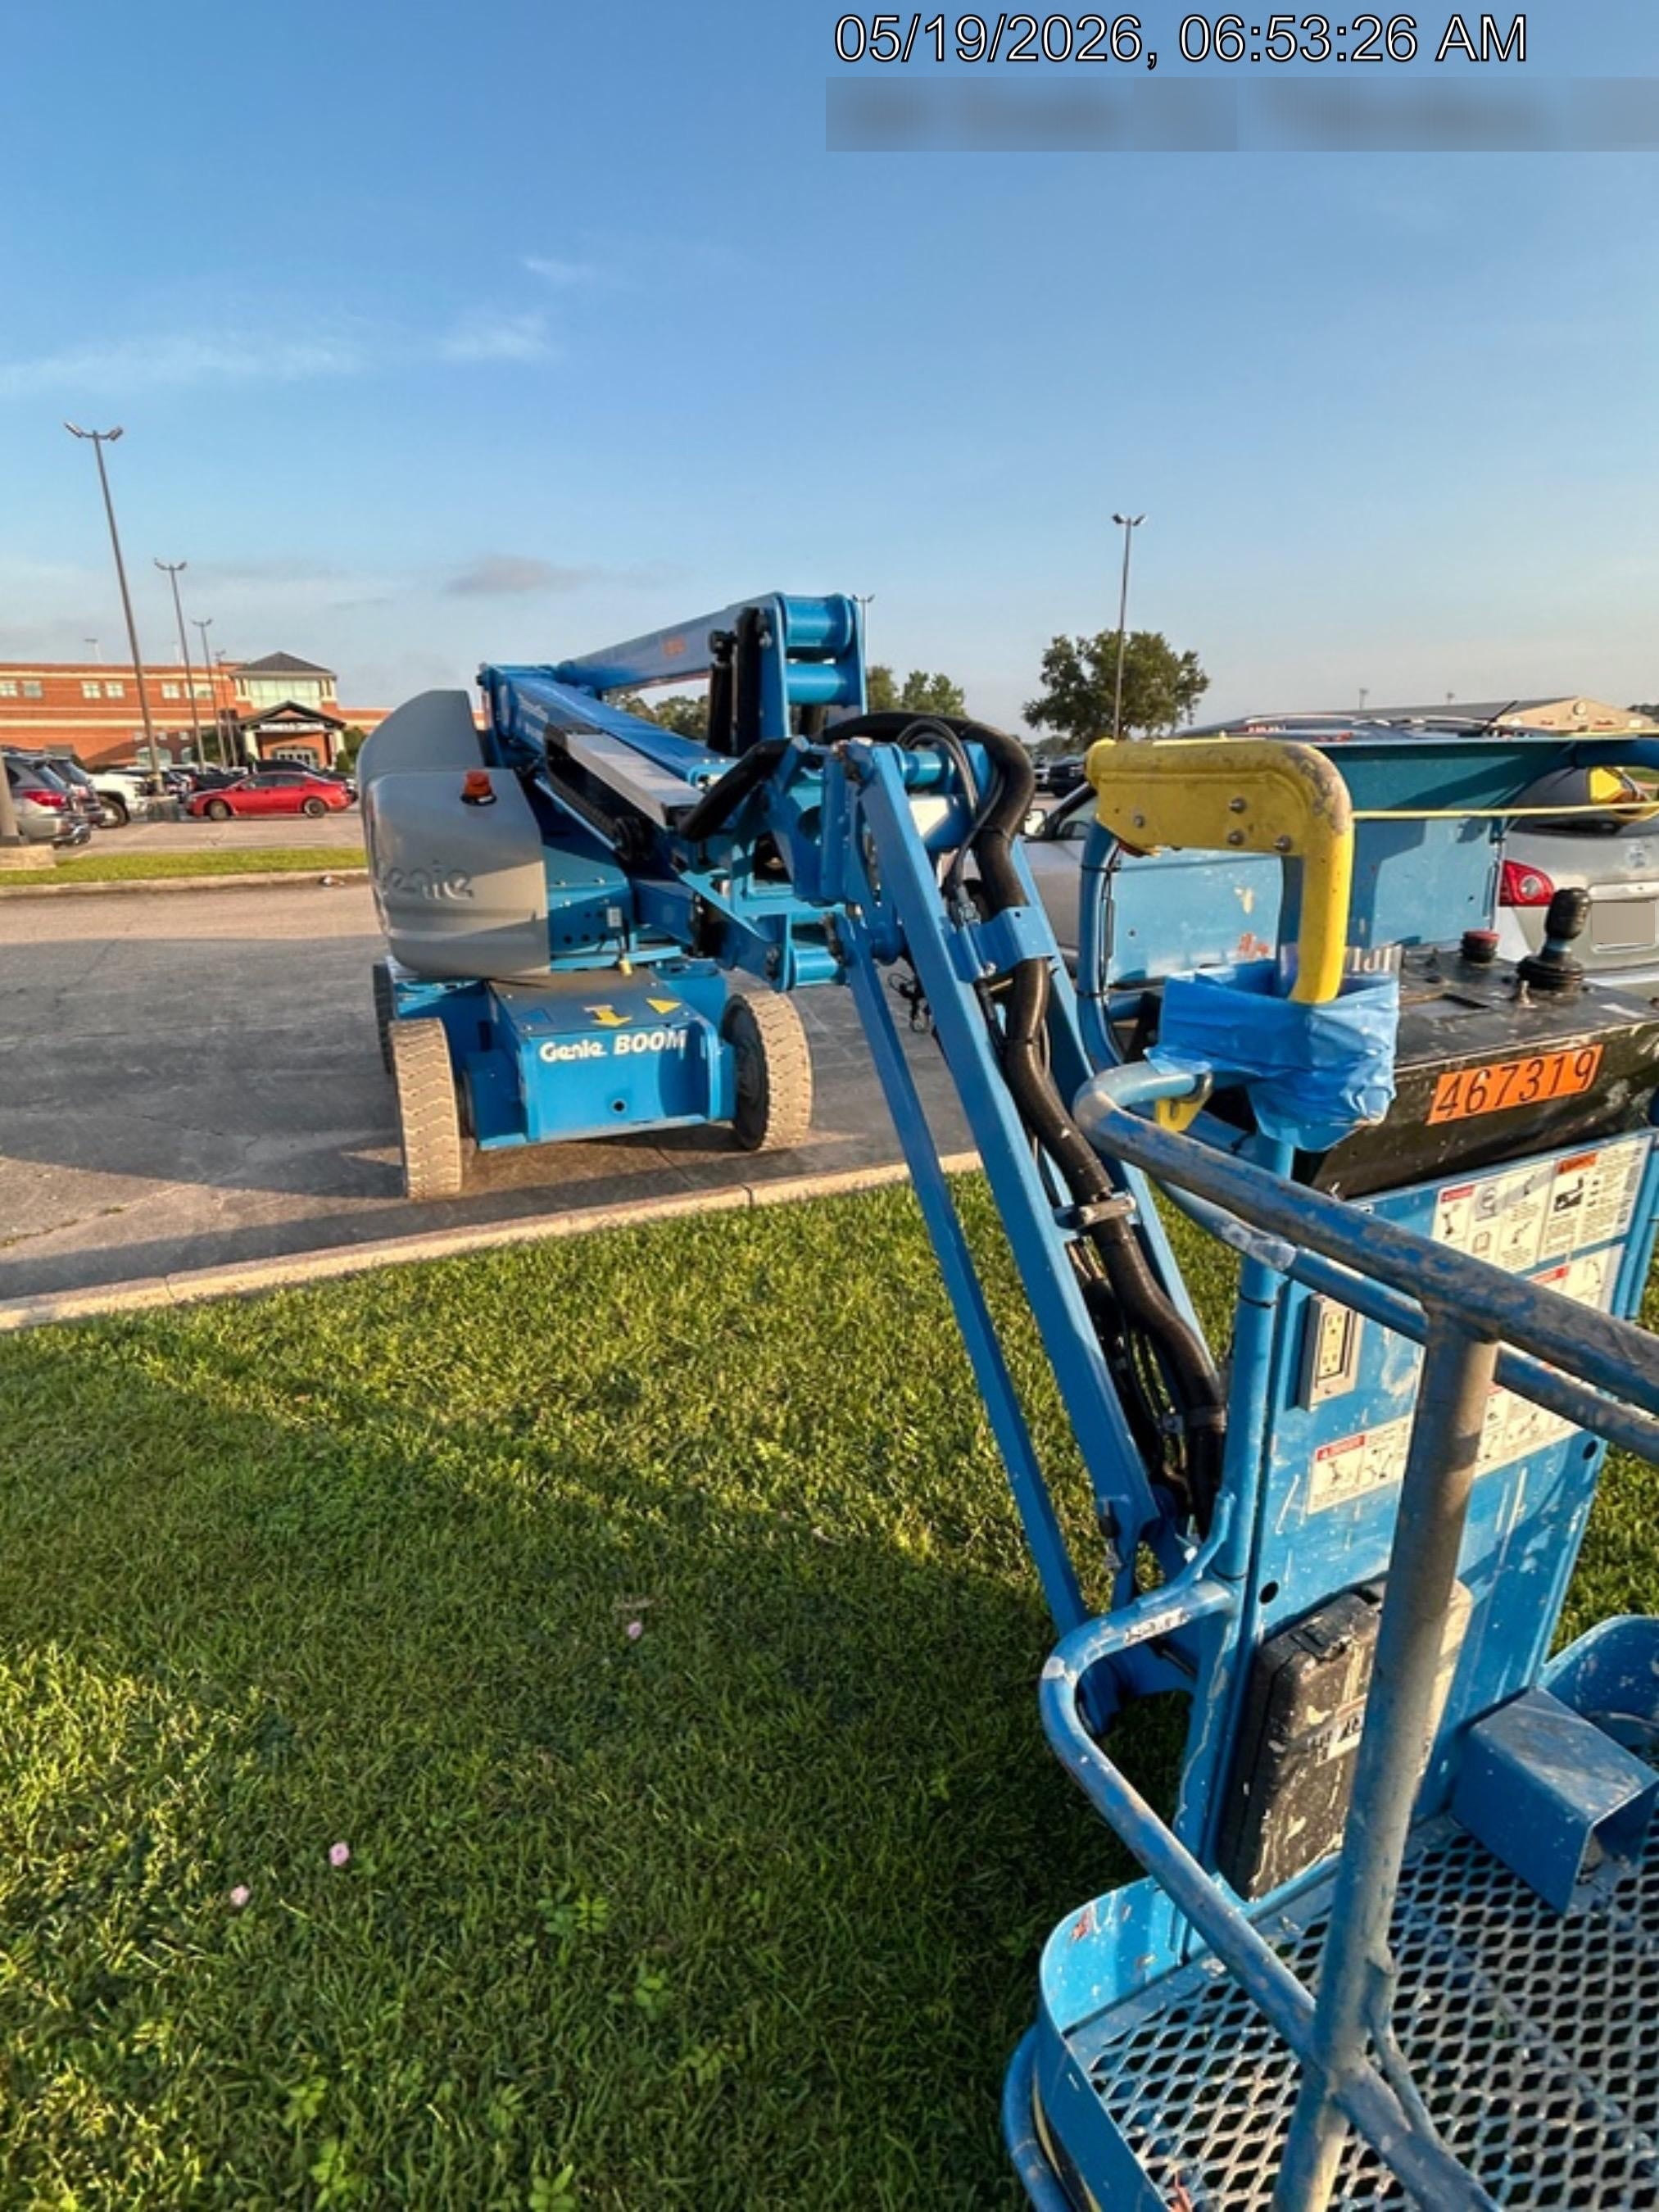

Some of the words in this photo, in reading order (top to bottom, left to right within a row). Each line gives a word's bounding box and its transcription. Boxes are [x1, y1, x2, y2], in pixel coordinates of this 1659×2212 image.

[539, 1040, 608, 1063] Genie
[614, 1028, 688, 1057] BOOM
[1435, 1048, 1596, 1118] 467319
